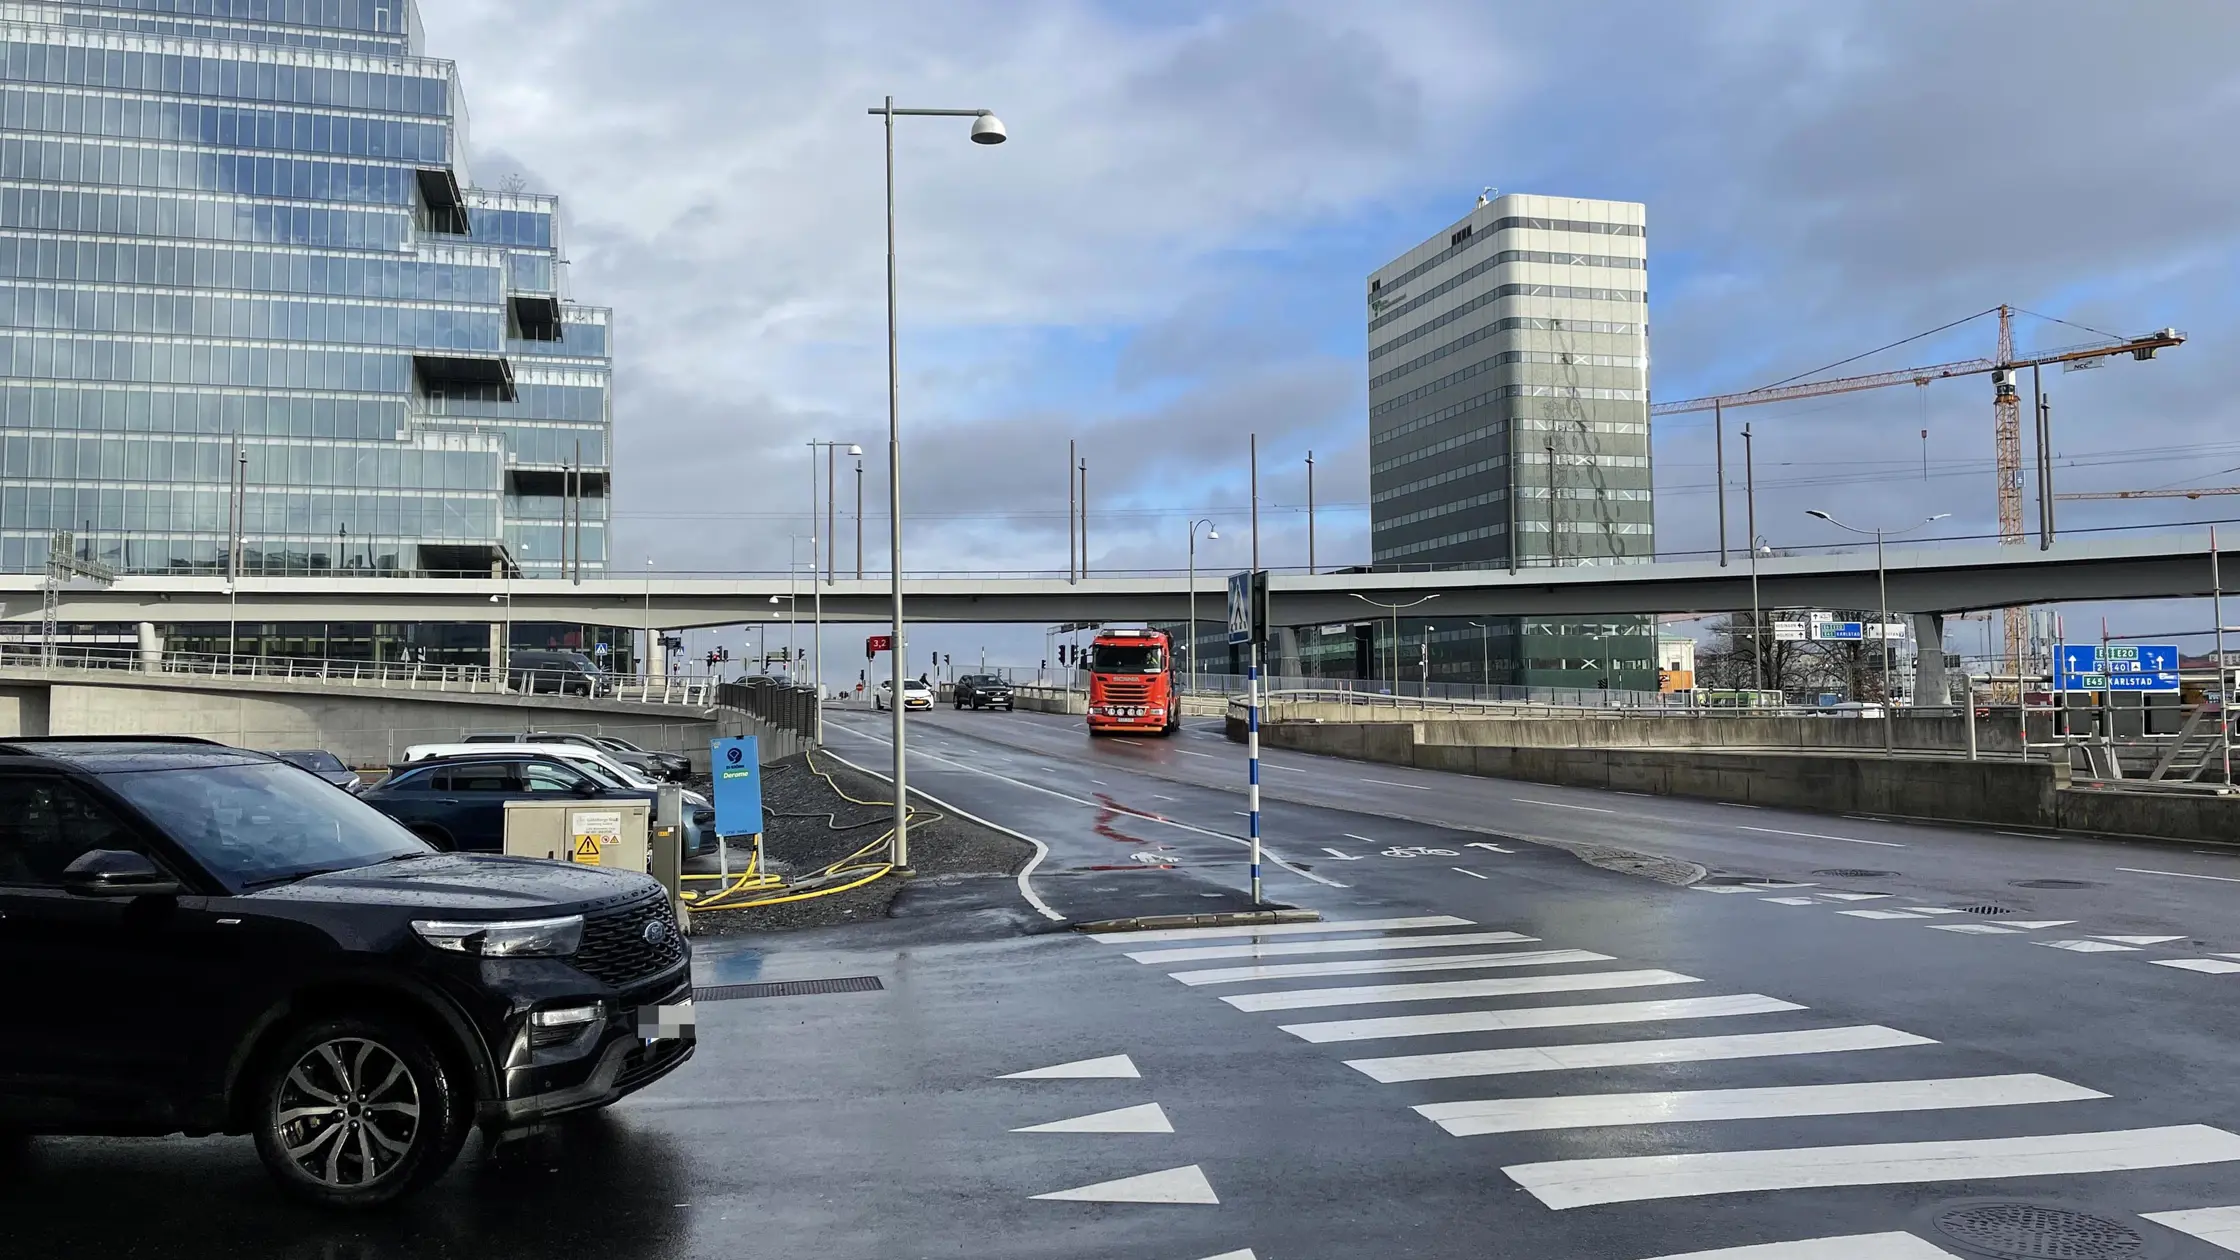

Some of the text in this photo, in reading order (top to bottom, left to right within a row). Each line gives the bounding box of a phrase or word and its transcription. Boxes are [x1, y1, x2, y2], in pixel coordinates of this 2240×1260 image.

[873, 639, 886, 648] 3,2
[2117, 649, 2134, 657] E20
[2114, 664, 2126, 672] 40
[2086, 678, 2153, 686] E45 KARLSTAD
[723, 771, 749, 779] Derome
